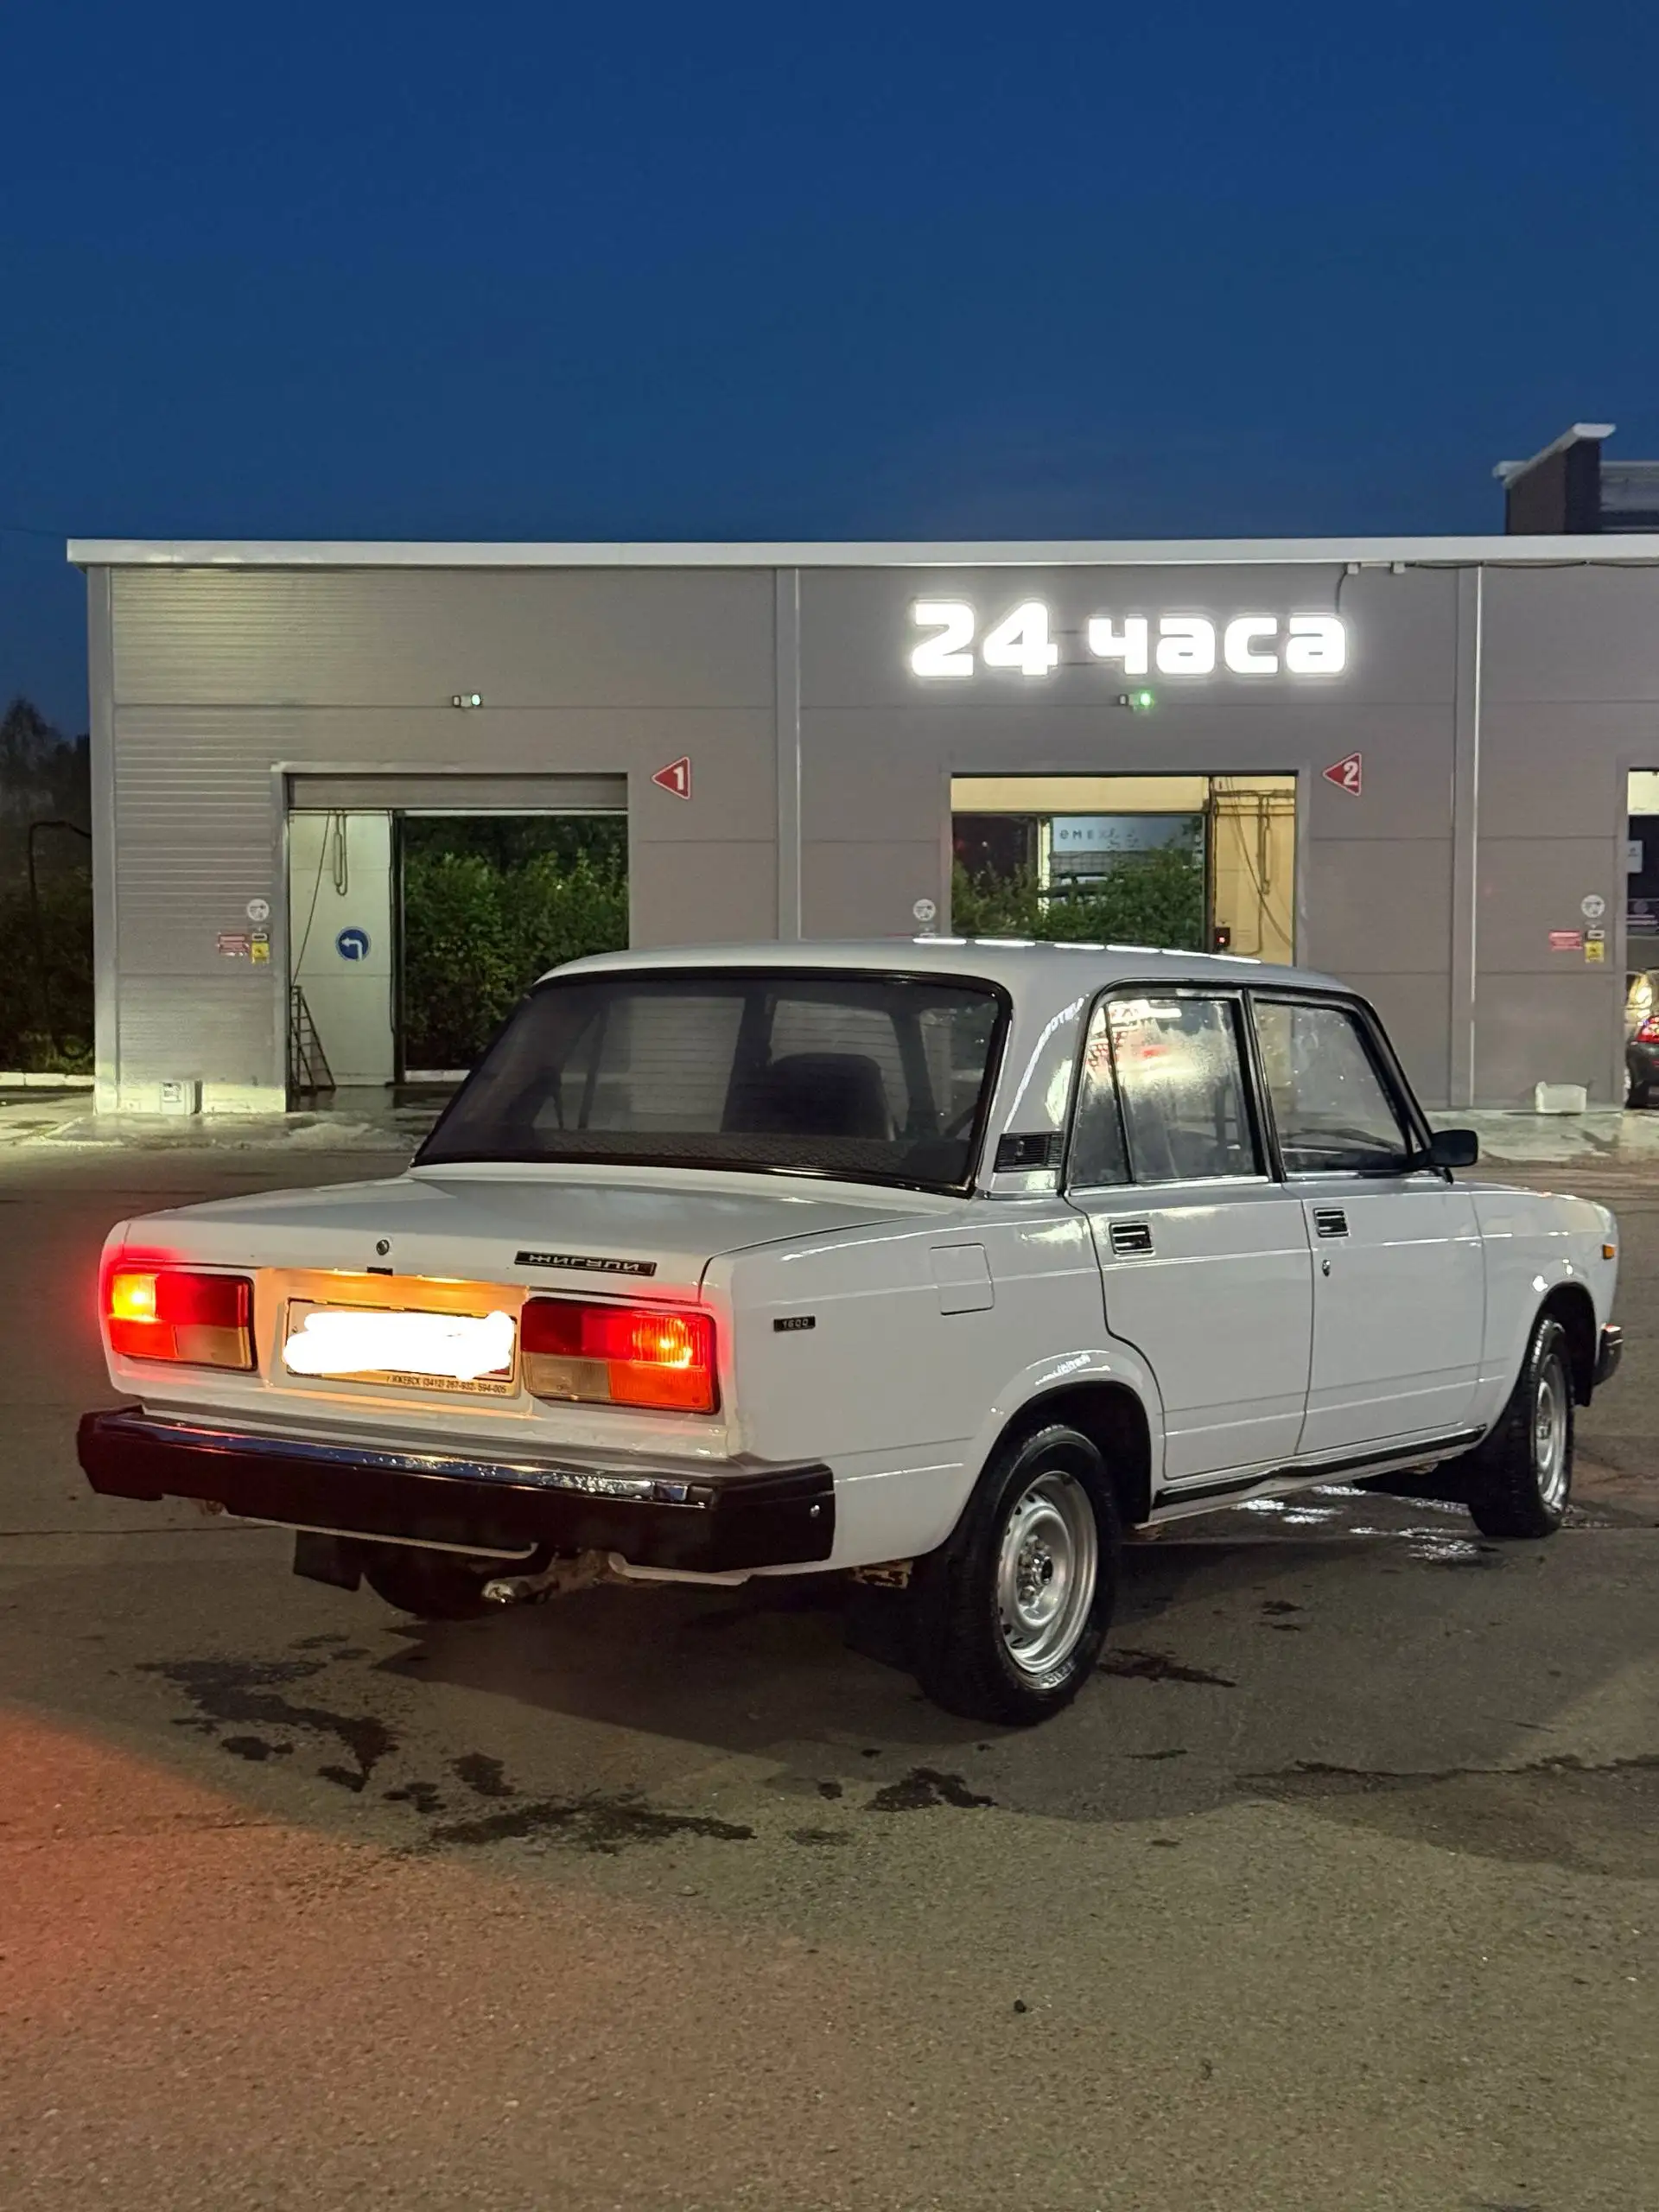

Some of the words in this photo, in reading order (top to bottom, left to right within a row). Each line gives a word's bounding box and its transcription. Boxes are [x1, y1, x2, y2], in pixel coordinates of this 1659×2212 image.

[910, 600, 1058, 678] 24
[1088, 615, 1347, 676] часа
[673, 766, 684, 791] 1
[1344, 761, 1359, 786] 2
[528, 1254, 640, 1271] ЖИГУЛИ
